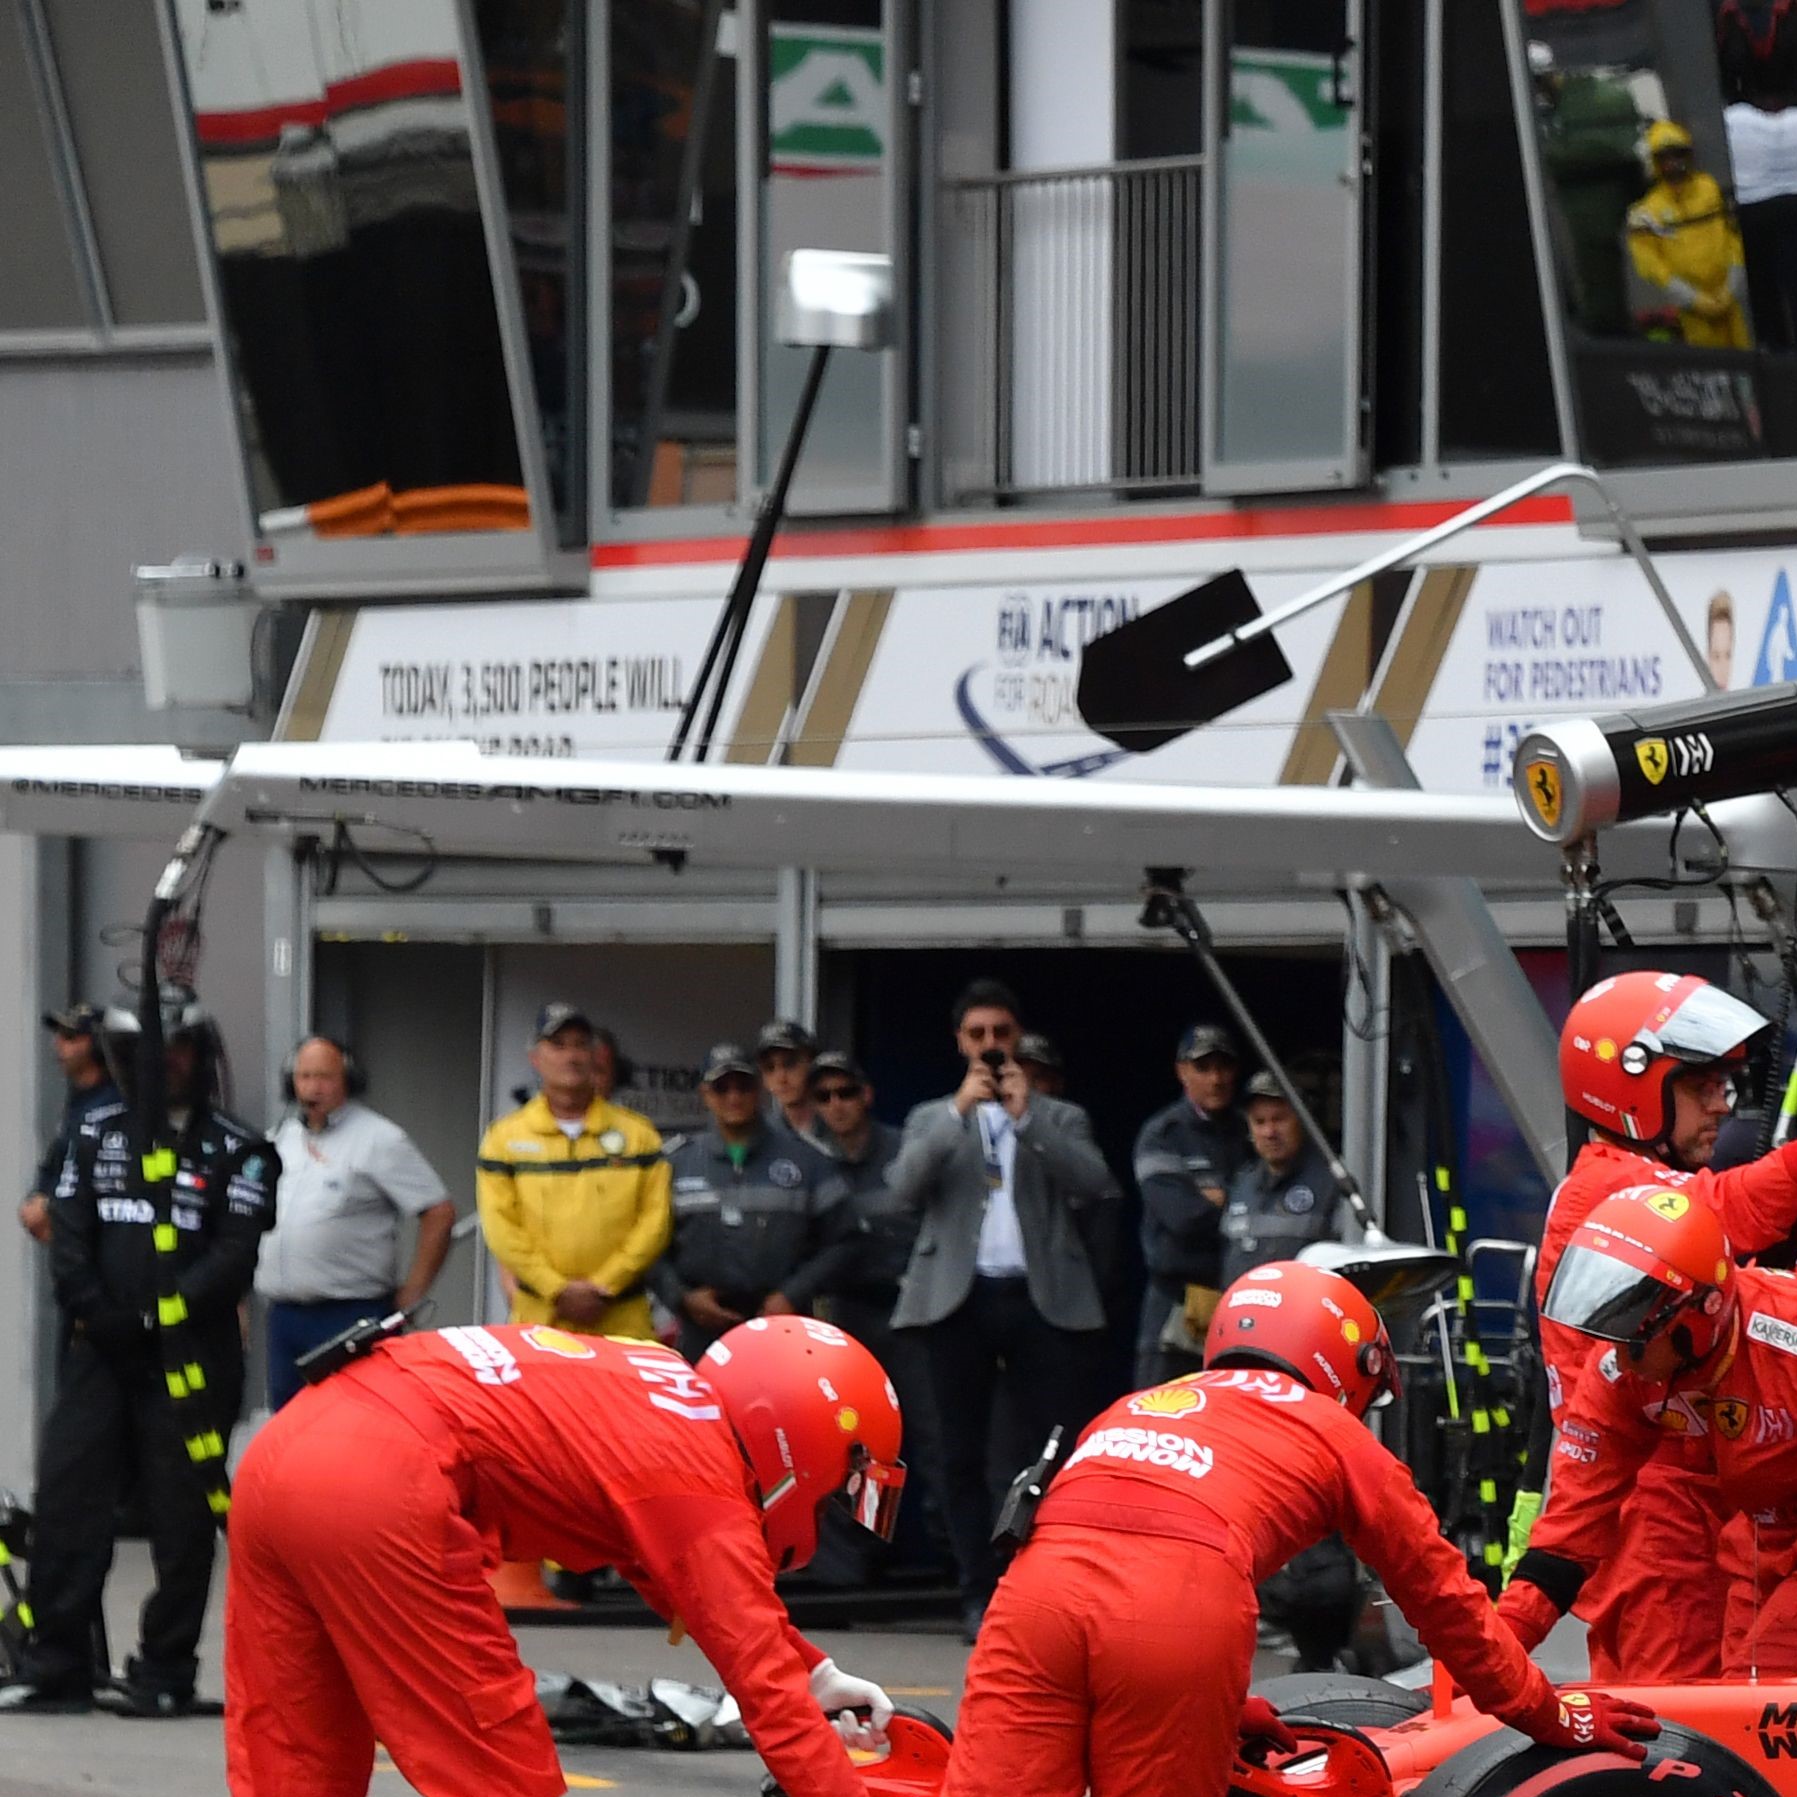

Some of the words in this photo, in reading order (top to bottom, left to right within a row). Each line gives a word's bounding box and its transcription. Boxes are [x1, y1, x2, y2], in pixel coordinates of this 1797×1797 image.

[1486, 610, 1550, 650] WATCH
[1560, 606, 1603, 647] OUT
[380, 662, 455, 718] TODAY,
[461, 662, 522, 717] 3,500
[529, 657, 619, 713] PEOPLE
[627, 655, 688, 711] WILL
[1484, 661, 1525, 701] FOR
[1530, 656, 1664, 699] PEDESTRIANS
[1312, 1351, 1341, 1389] HUBLOT
